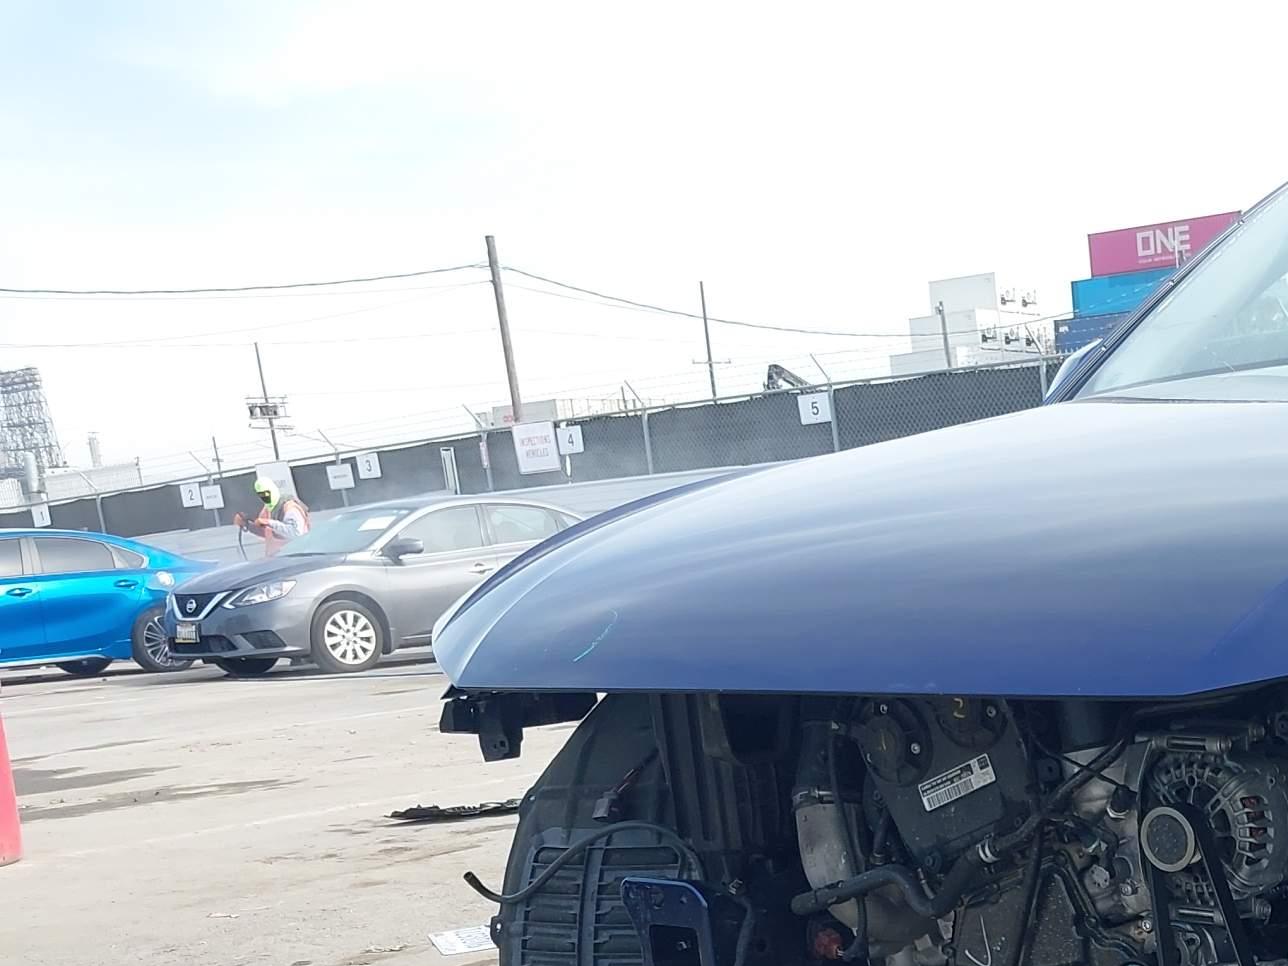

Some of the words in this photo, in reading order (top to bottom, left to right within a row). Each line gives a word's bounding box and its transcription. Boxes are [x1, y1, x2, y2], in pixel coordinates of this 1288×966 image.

[1136, 225, 1191, 257] ONE
[811, 401, 820, 416] 5
[567, 433, 575, 447] 4
[365, 459, 372, 473] 3
[188, 488, 195, 501] 2
